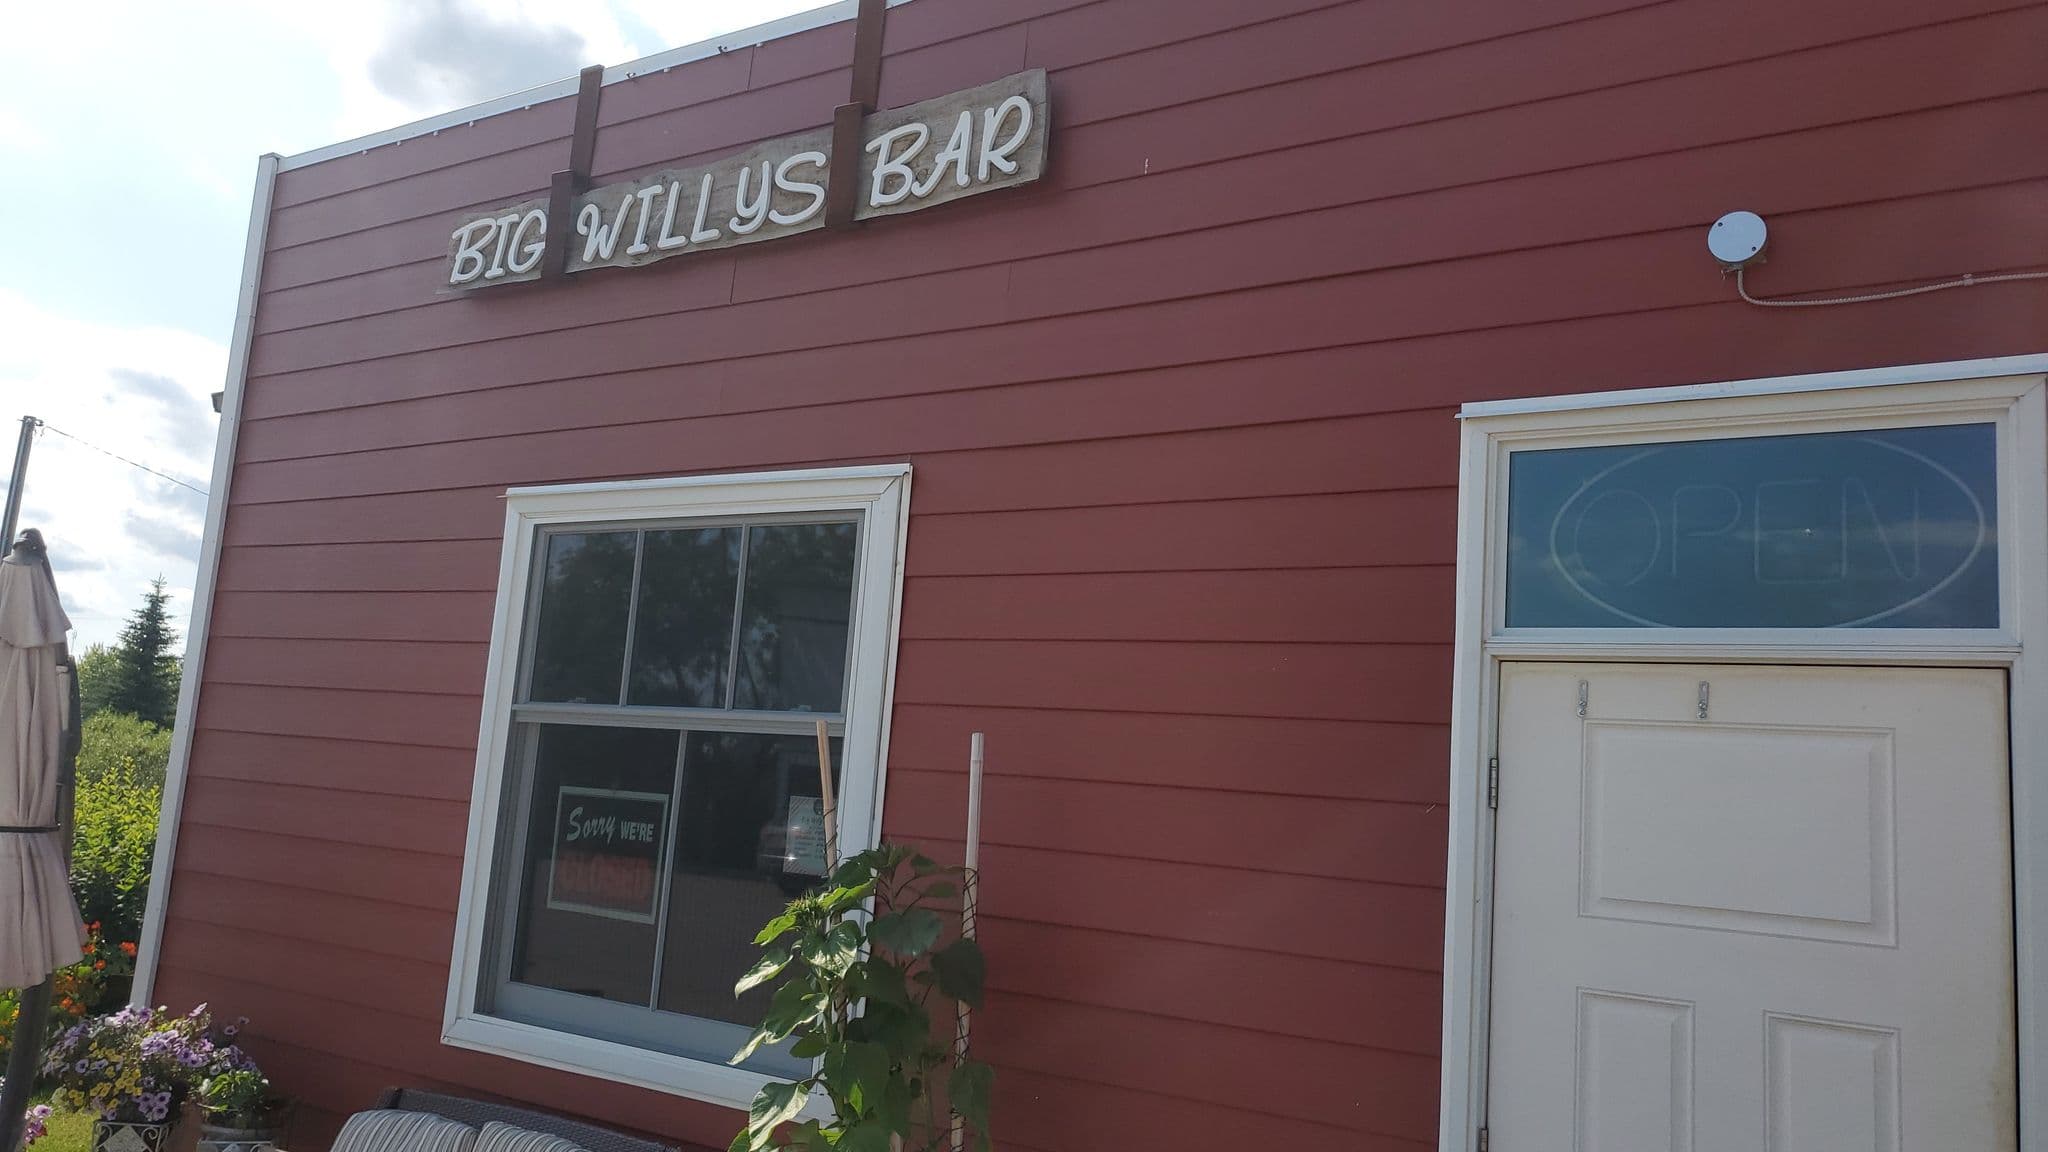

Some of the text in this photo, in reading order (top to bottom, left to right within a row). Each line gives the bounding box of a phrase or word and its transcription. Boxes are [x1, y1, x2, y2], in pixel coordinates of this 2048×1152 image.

[450, 95, 1034, 284] BIG WILLYS BAR
[1574, 476, 1921, 587] OPEN
[566, 806, 655, 845] Sorry WE'RE
